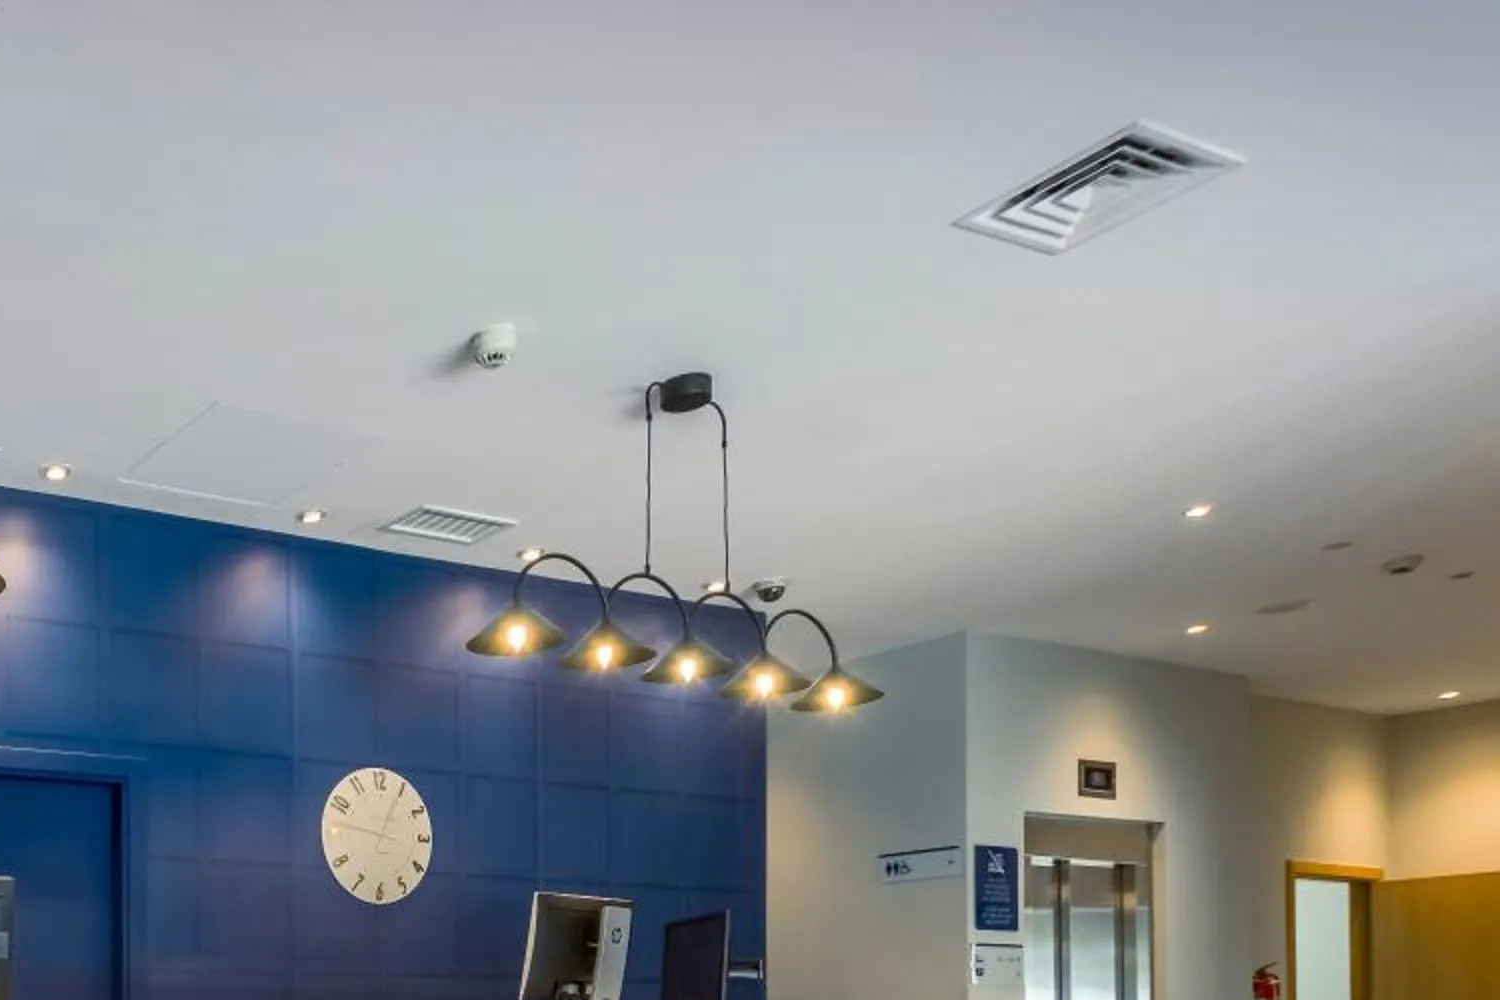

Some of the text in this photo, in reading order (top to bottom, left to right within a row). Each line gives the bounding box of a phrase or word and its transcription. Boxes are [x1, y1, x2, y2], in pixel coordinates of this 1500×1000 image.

[350, 775, 366, 795] 11
[372, 771, 387, 792] 12
[329, 794, 350, 816] 10
[411, 805, 425, 819] 2
[417, 833, 431, 844] 3
[332, 854, 349, 869] 8
[412, 860, 425, 874] 4
[351, 873, 365, 892] 7
[375, 882, 385, 901] 6
[397, 876, 408, 895] 5
